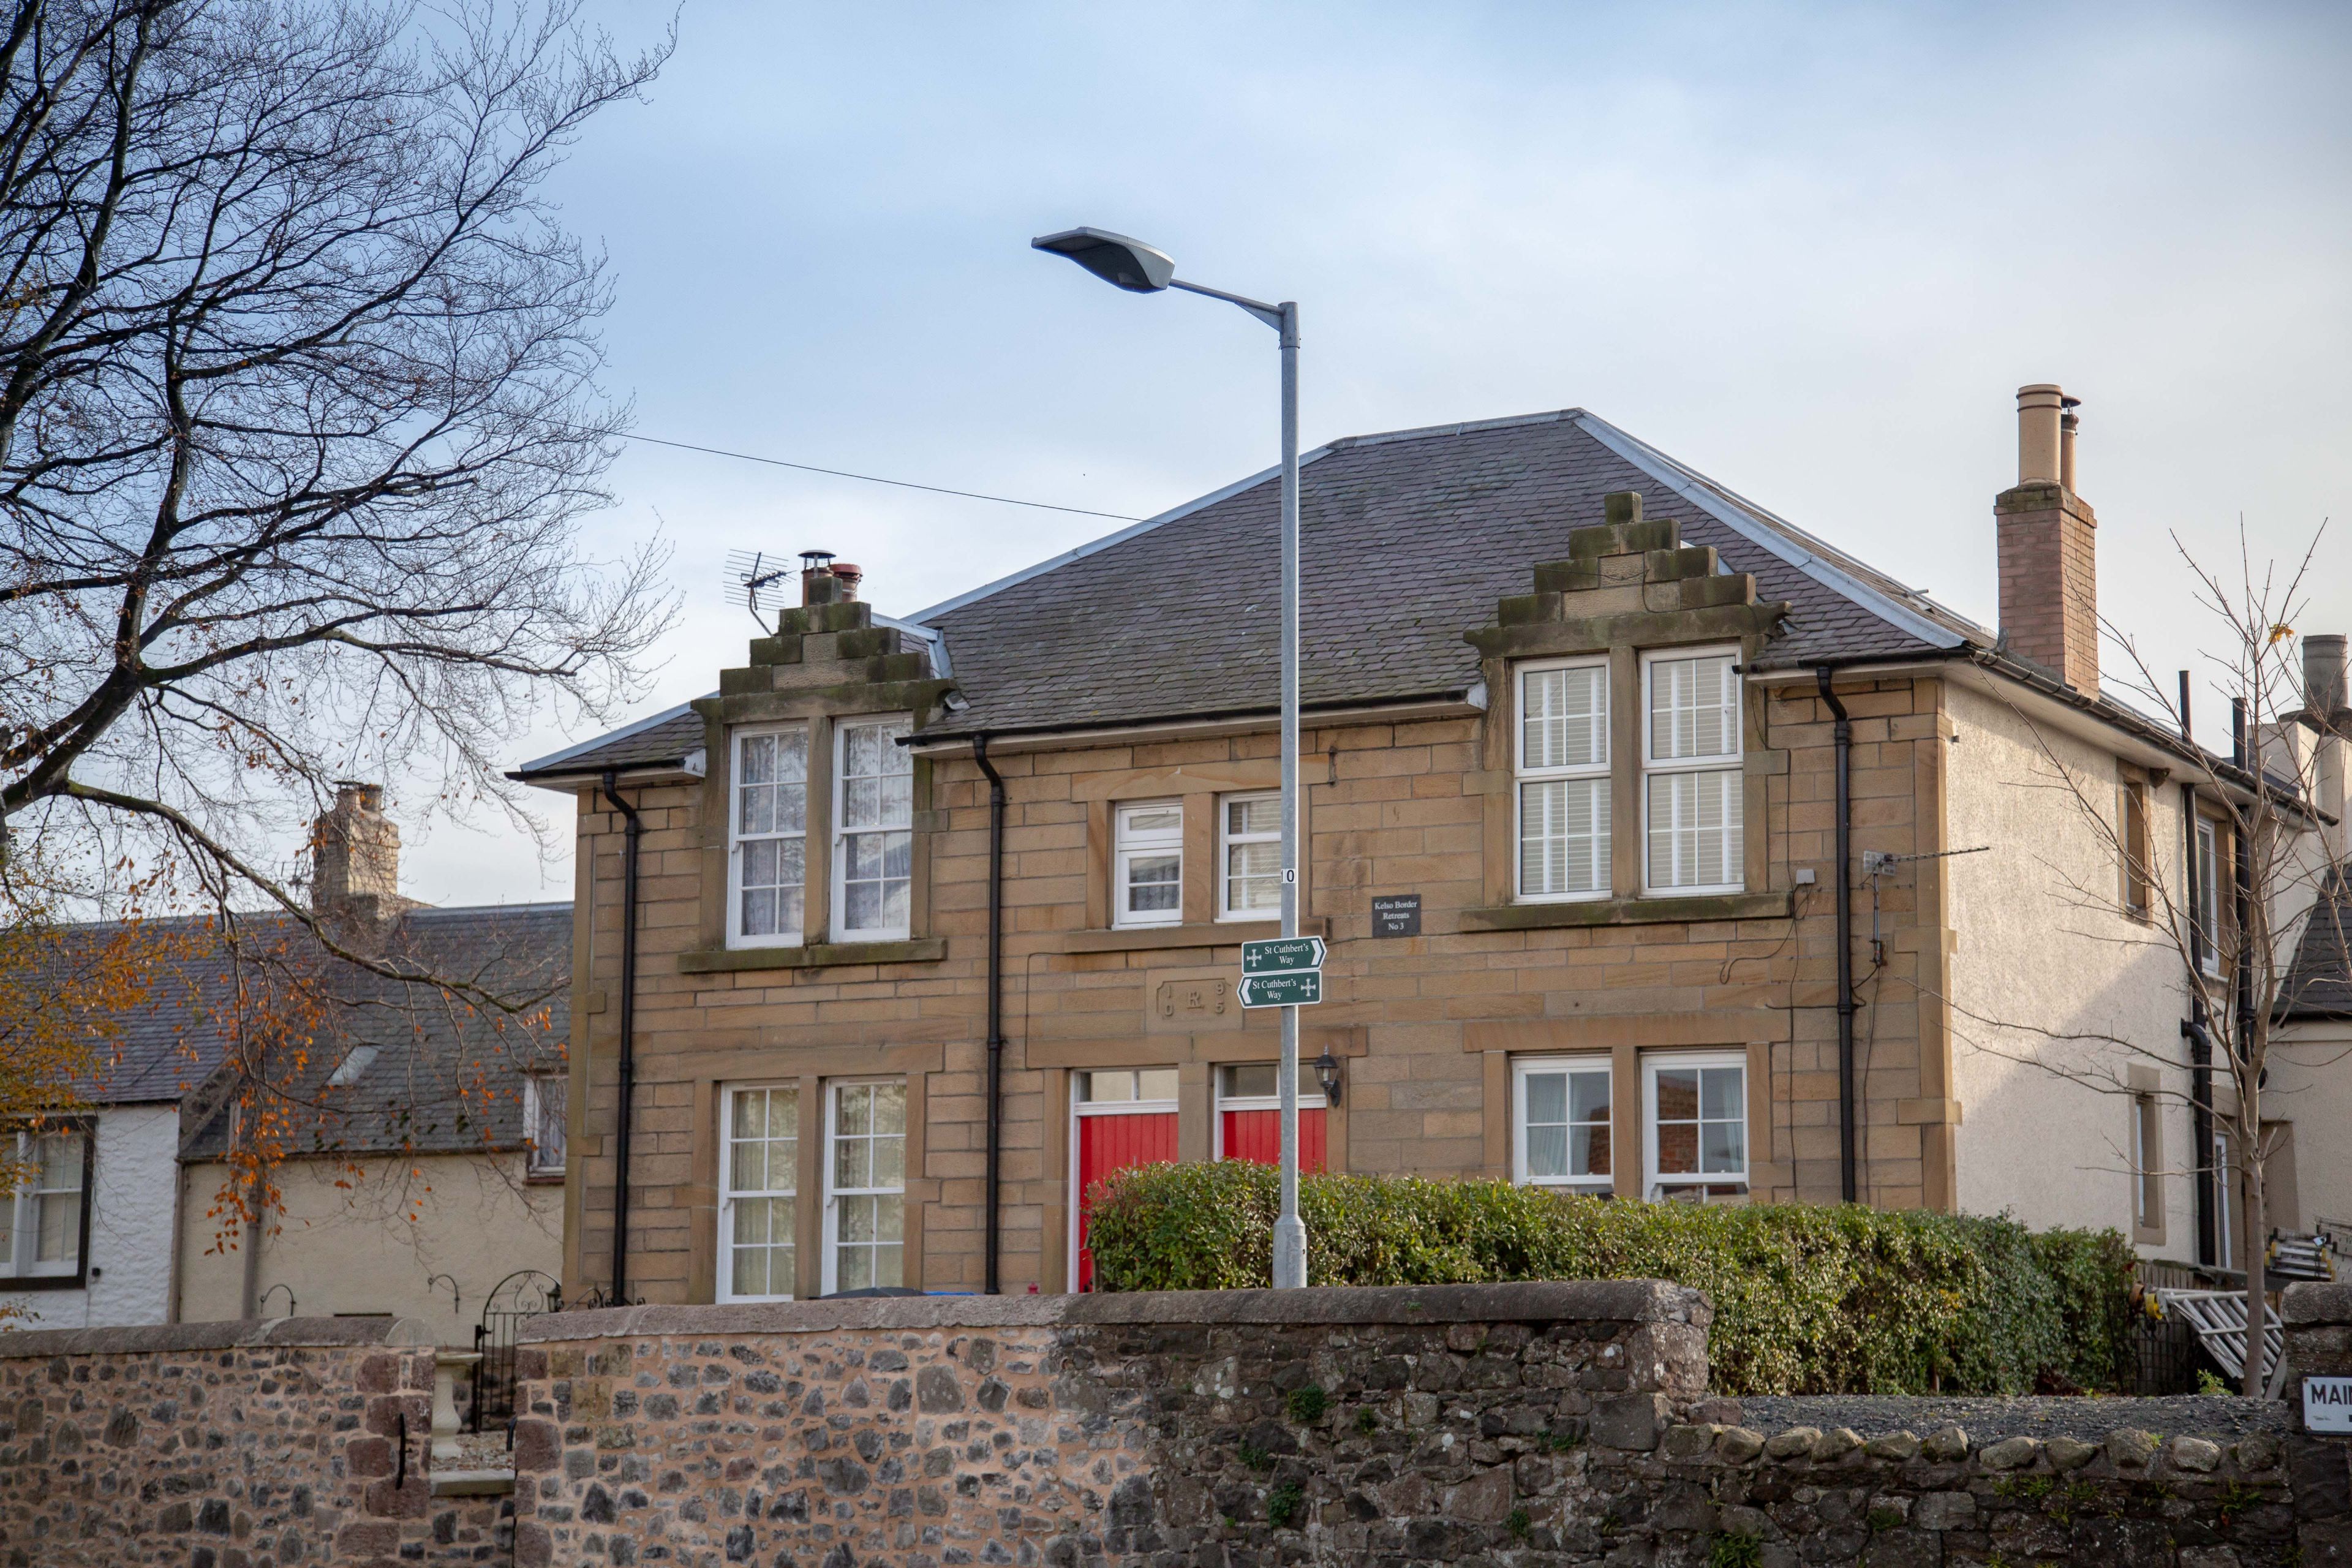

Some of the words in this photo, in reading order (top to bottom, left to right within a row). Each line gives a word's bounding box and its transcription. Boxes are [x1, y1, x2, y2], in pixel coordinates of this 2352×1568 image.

[1374, 902, 1393, 910] Kelso
[1395, 900, 1417, 909] Border
[1400, 921, 1404, 930] 3
[1274, 943, 1309, 954] Cuthbert's
[1279, 956, 1294, 965] Way
[1262, 979, 1297, 989] Cuthbert's
[1267, 991, 1282, 1000] Way
